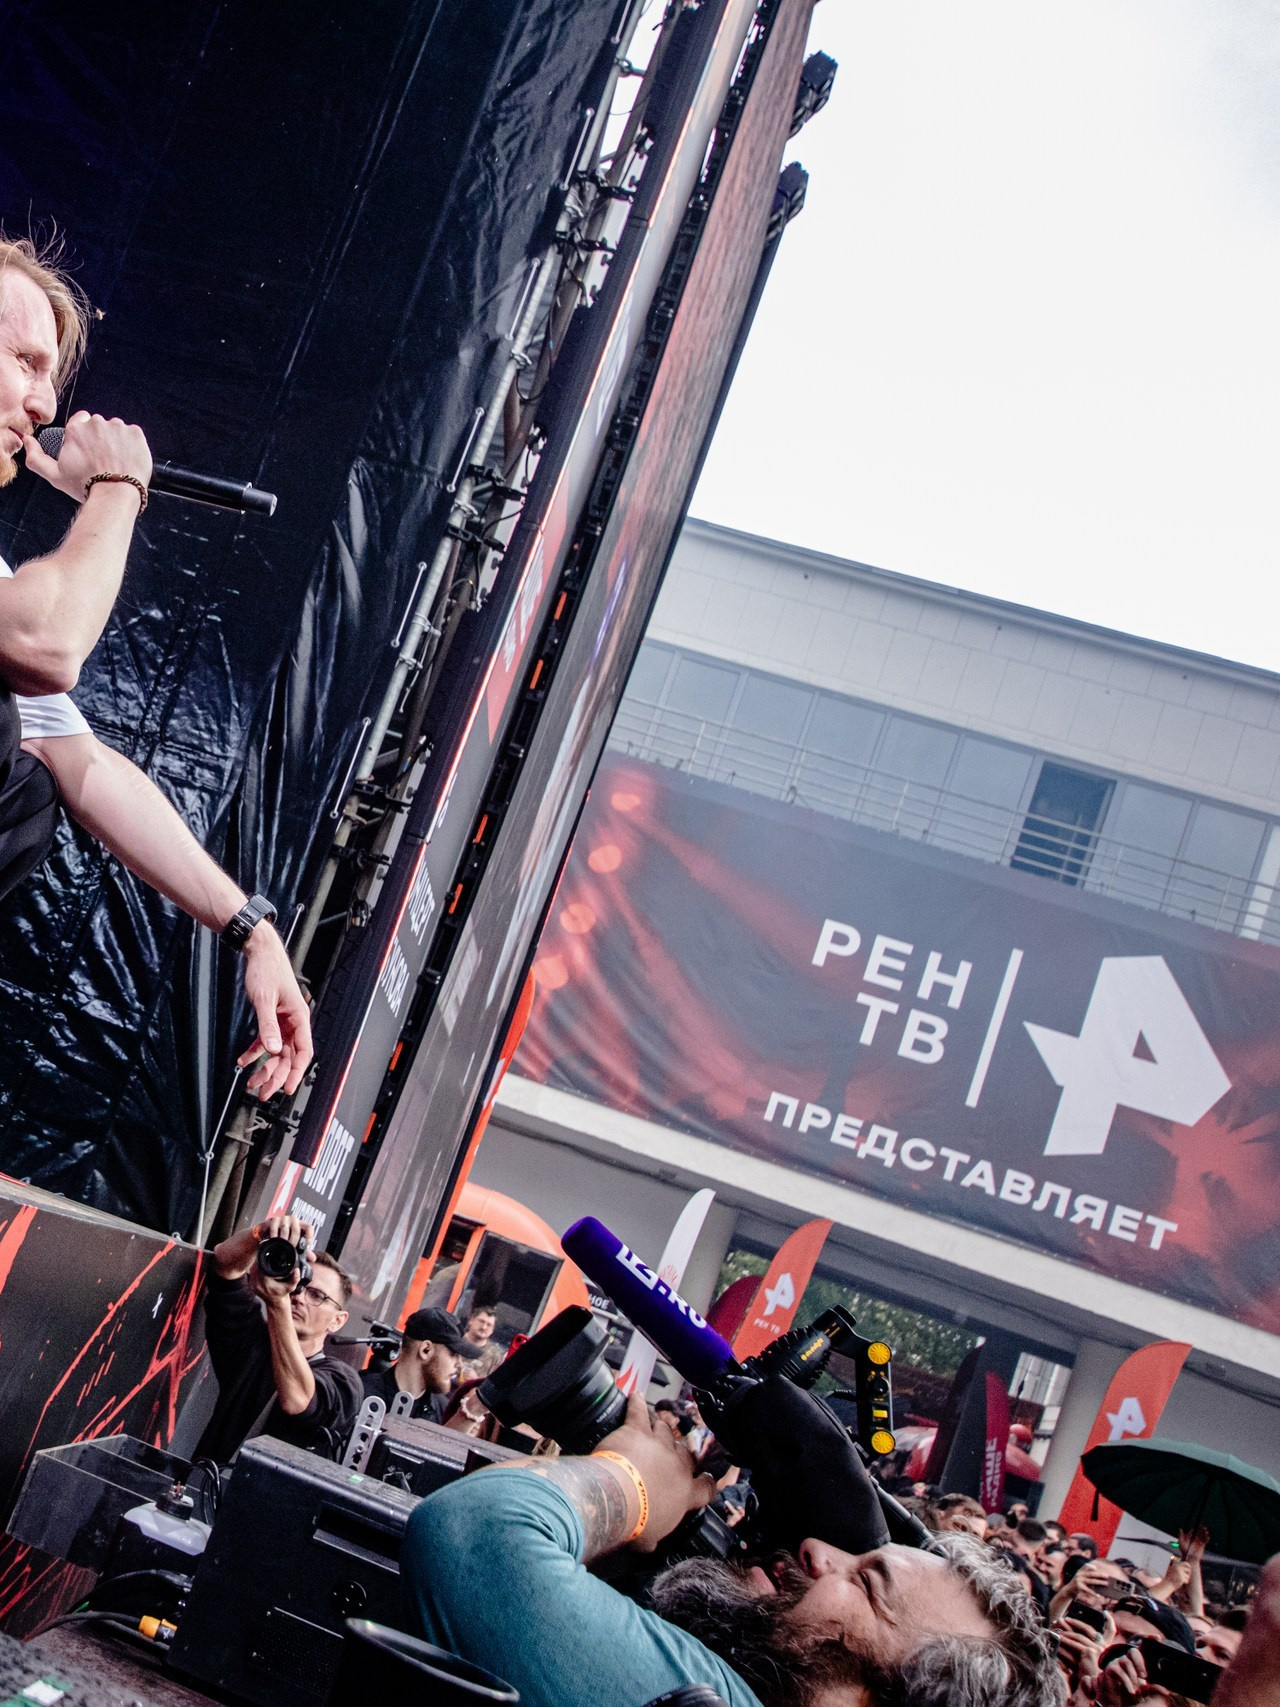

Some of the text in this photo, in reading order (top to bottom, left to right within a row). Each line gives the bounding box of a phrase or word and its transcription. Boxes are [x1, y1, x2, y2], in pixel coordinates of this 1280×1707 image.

[811, 918, 973, 1010] РЕН
[856, 992, 950, 1065] ТВ
[764, 1091, 1179, 1250] ПРЕДСТАВЛЯЕТ
[589, 1293, 610, 1310] НОЕ
